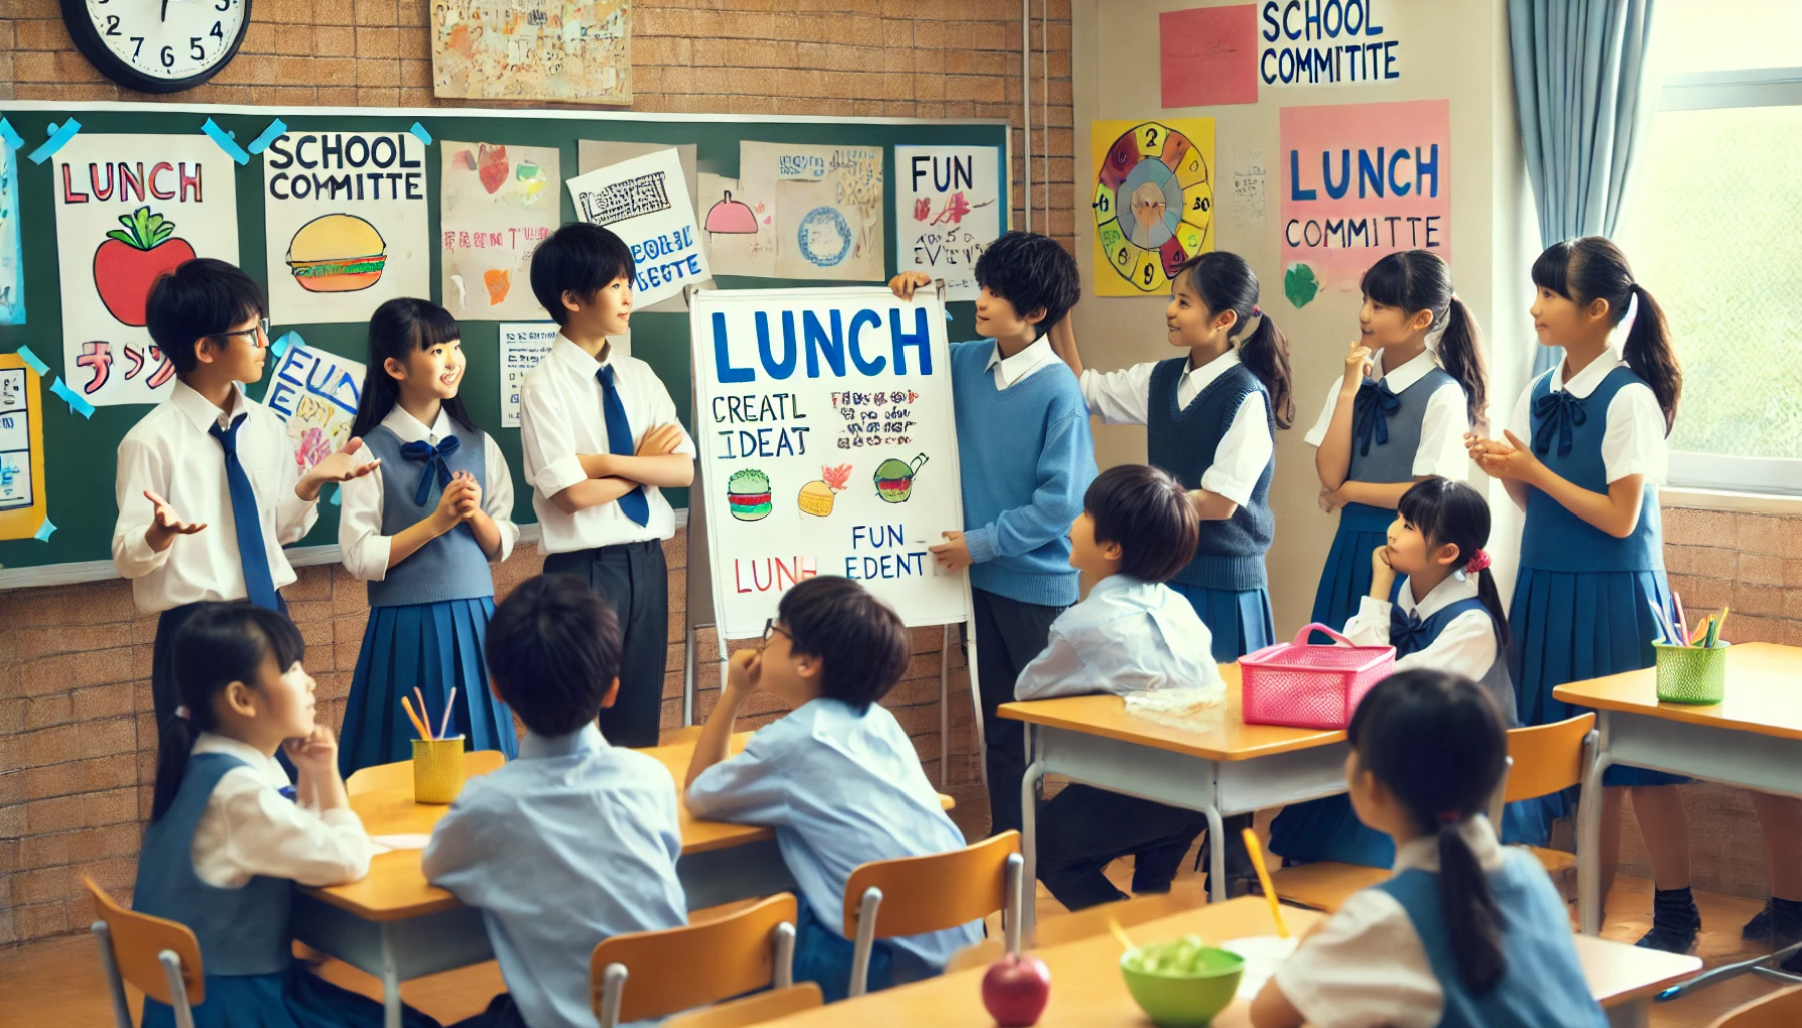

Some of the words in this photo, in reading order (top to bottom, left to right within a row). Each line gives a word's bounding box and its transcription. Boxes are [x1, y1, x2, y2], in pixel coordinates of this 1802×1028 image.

[106, 15, 122, 36] 2
[1262, 0, 1384, 42] SCHOOL
[160, 46, 175, 67] 6
[190, 37, 206, 60] 5
[269, 134, 422, 169] SCHOOL
[1145, 128, 1158, 147] 2
[61, 161, 203, 204] LUNCH
[911, 155, 973, 192] FUN
[1290, 144, 1439, 201] LUNCH
[1285, 216, 1441, 248] COMMITTE
[712, 307, 933, 383] LUNCH
[852, 524, 904, 549] FUN
